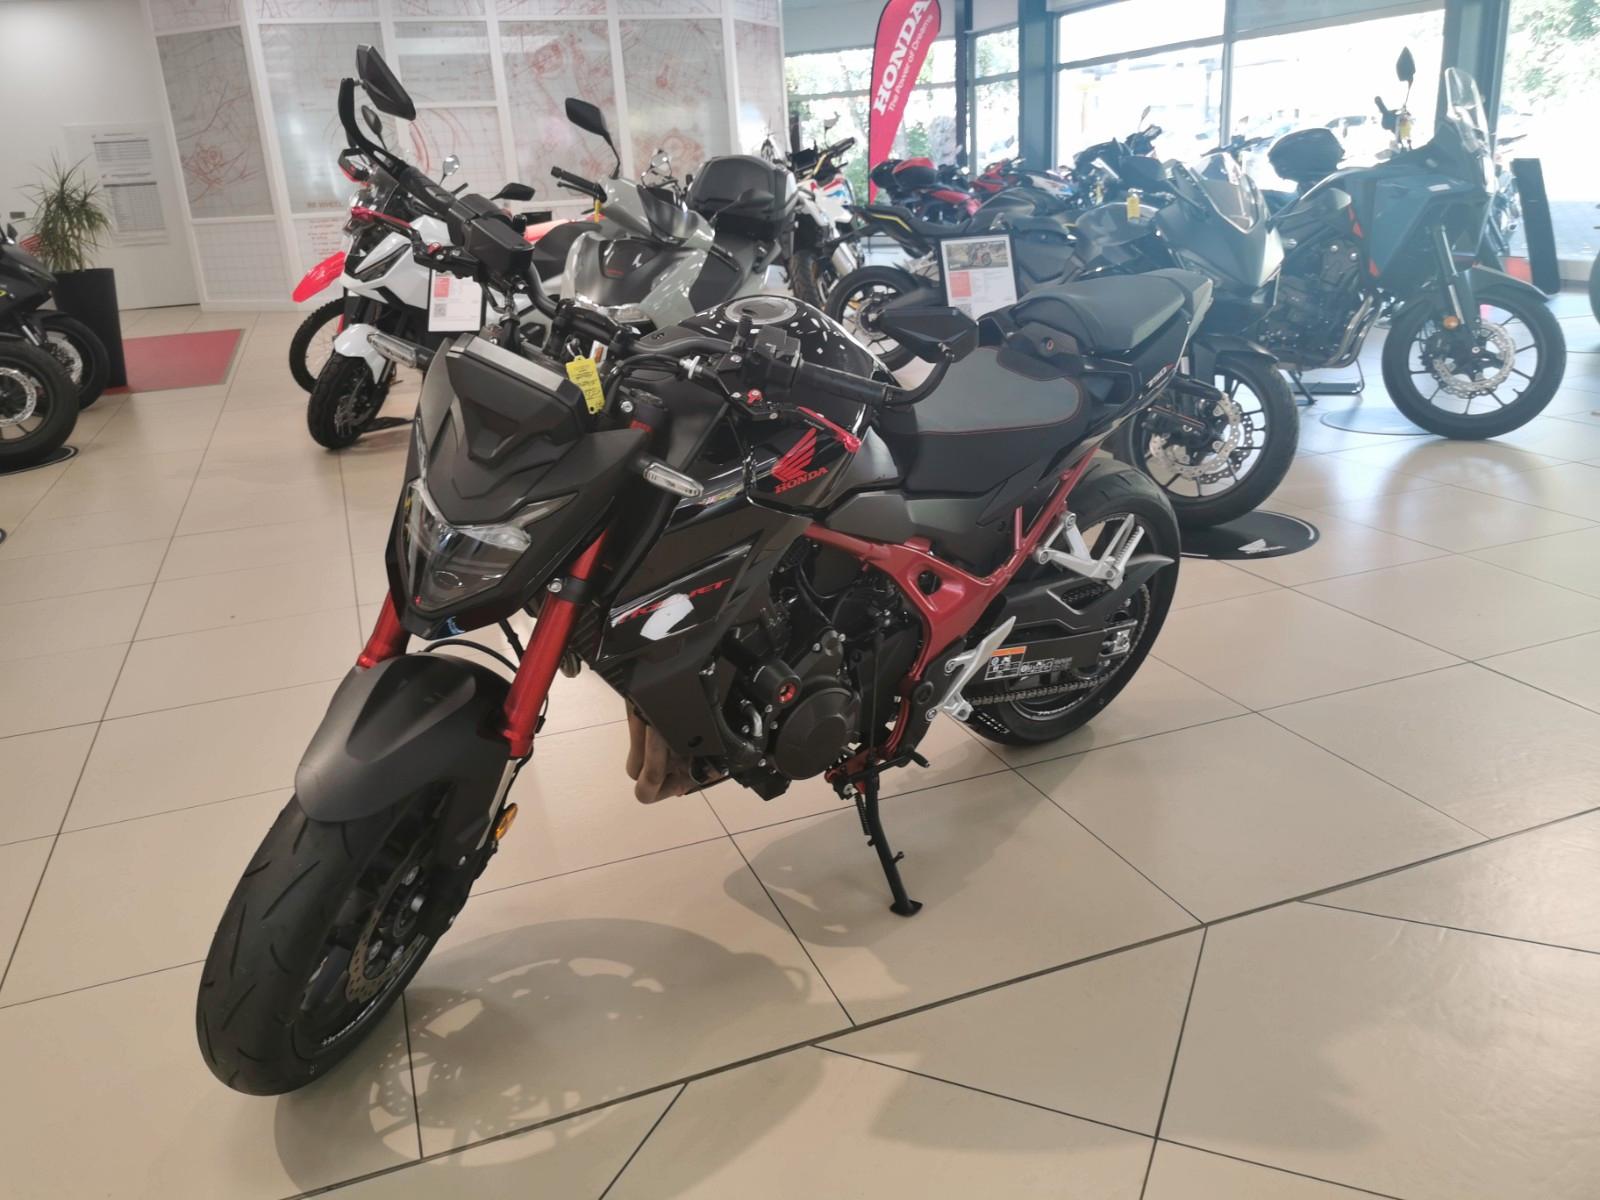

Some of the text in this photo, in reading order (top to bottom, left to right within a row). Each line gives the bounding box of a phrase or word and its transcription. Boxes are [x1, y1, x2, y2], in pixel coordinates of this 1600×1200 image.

[873, 0, 931, 116] HONDA
[887, 94, 899, 112] The
[895, 62, 911, 94] Power
[907, 49, 916, 63] of
[774, 466, 829, 495] HONDA
